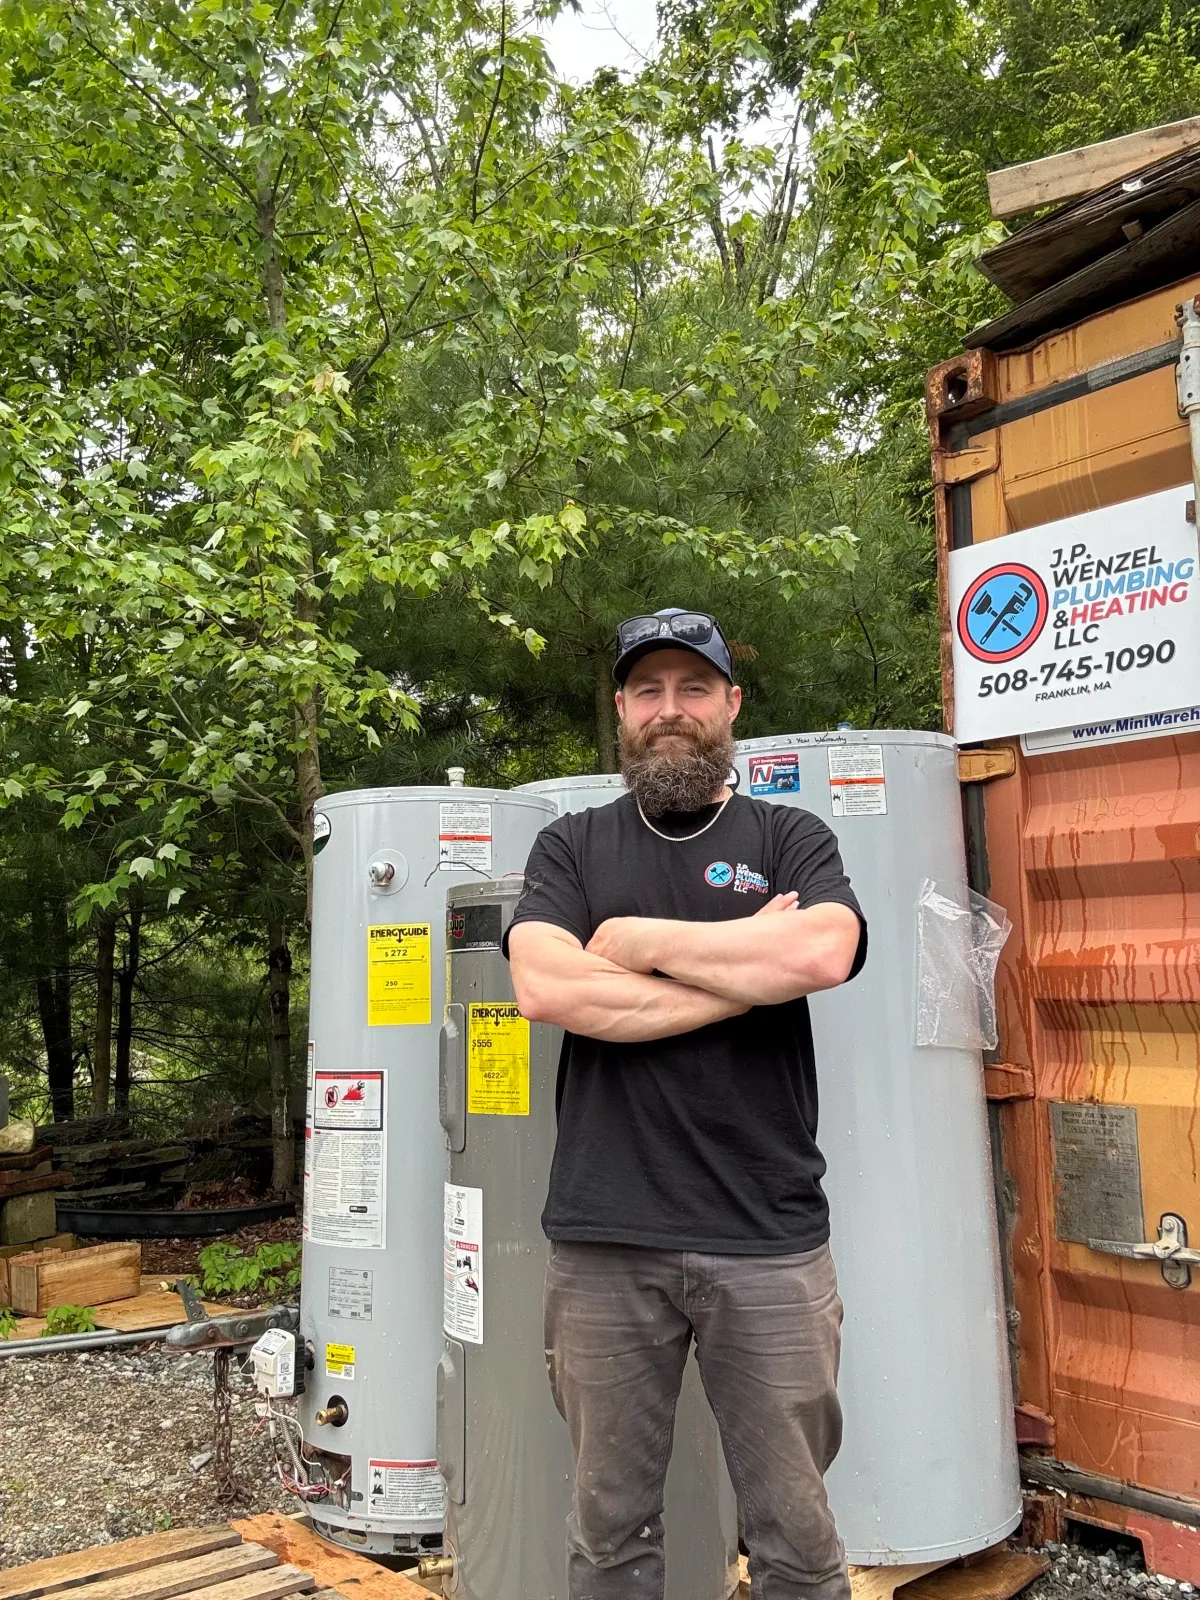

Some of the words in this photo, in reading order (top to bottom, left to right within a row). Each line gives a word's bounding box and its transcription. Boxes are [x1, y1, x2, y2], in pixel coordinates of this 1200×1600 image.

[1049, 543, 1091, 569] J.P.
[1052, 545, 1163, 588] WENZEL
[1052, 557, 1195, 610] PLUMBING
[1054, 623, 1100, 651] LLC
[977, 639, 1176, 698] 508-745-1090
[1035, 684, 1091, 702] FRANKLIN,
[1093, 680, 1112, 692] MA
[1072, 708, 1200, 739] www.MiniWareh
[814, 736, 847, 745] Warranty
[733, 885, 748, 894] LLC
[390, 949, 408, 957] 272
[472, 1038, 493, 1048] $555
